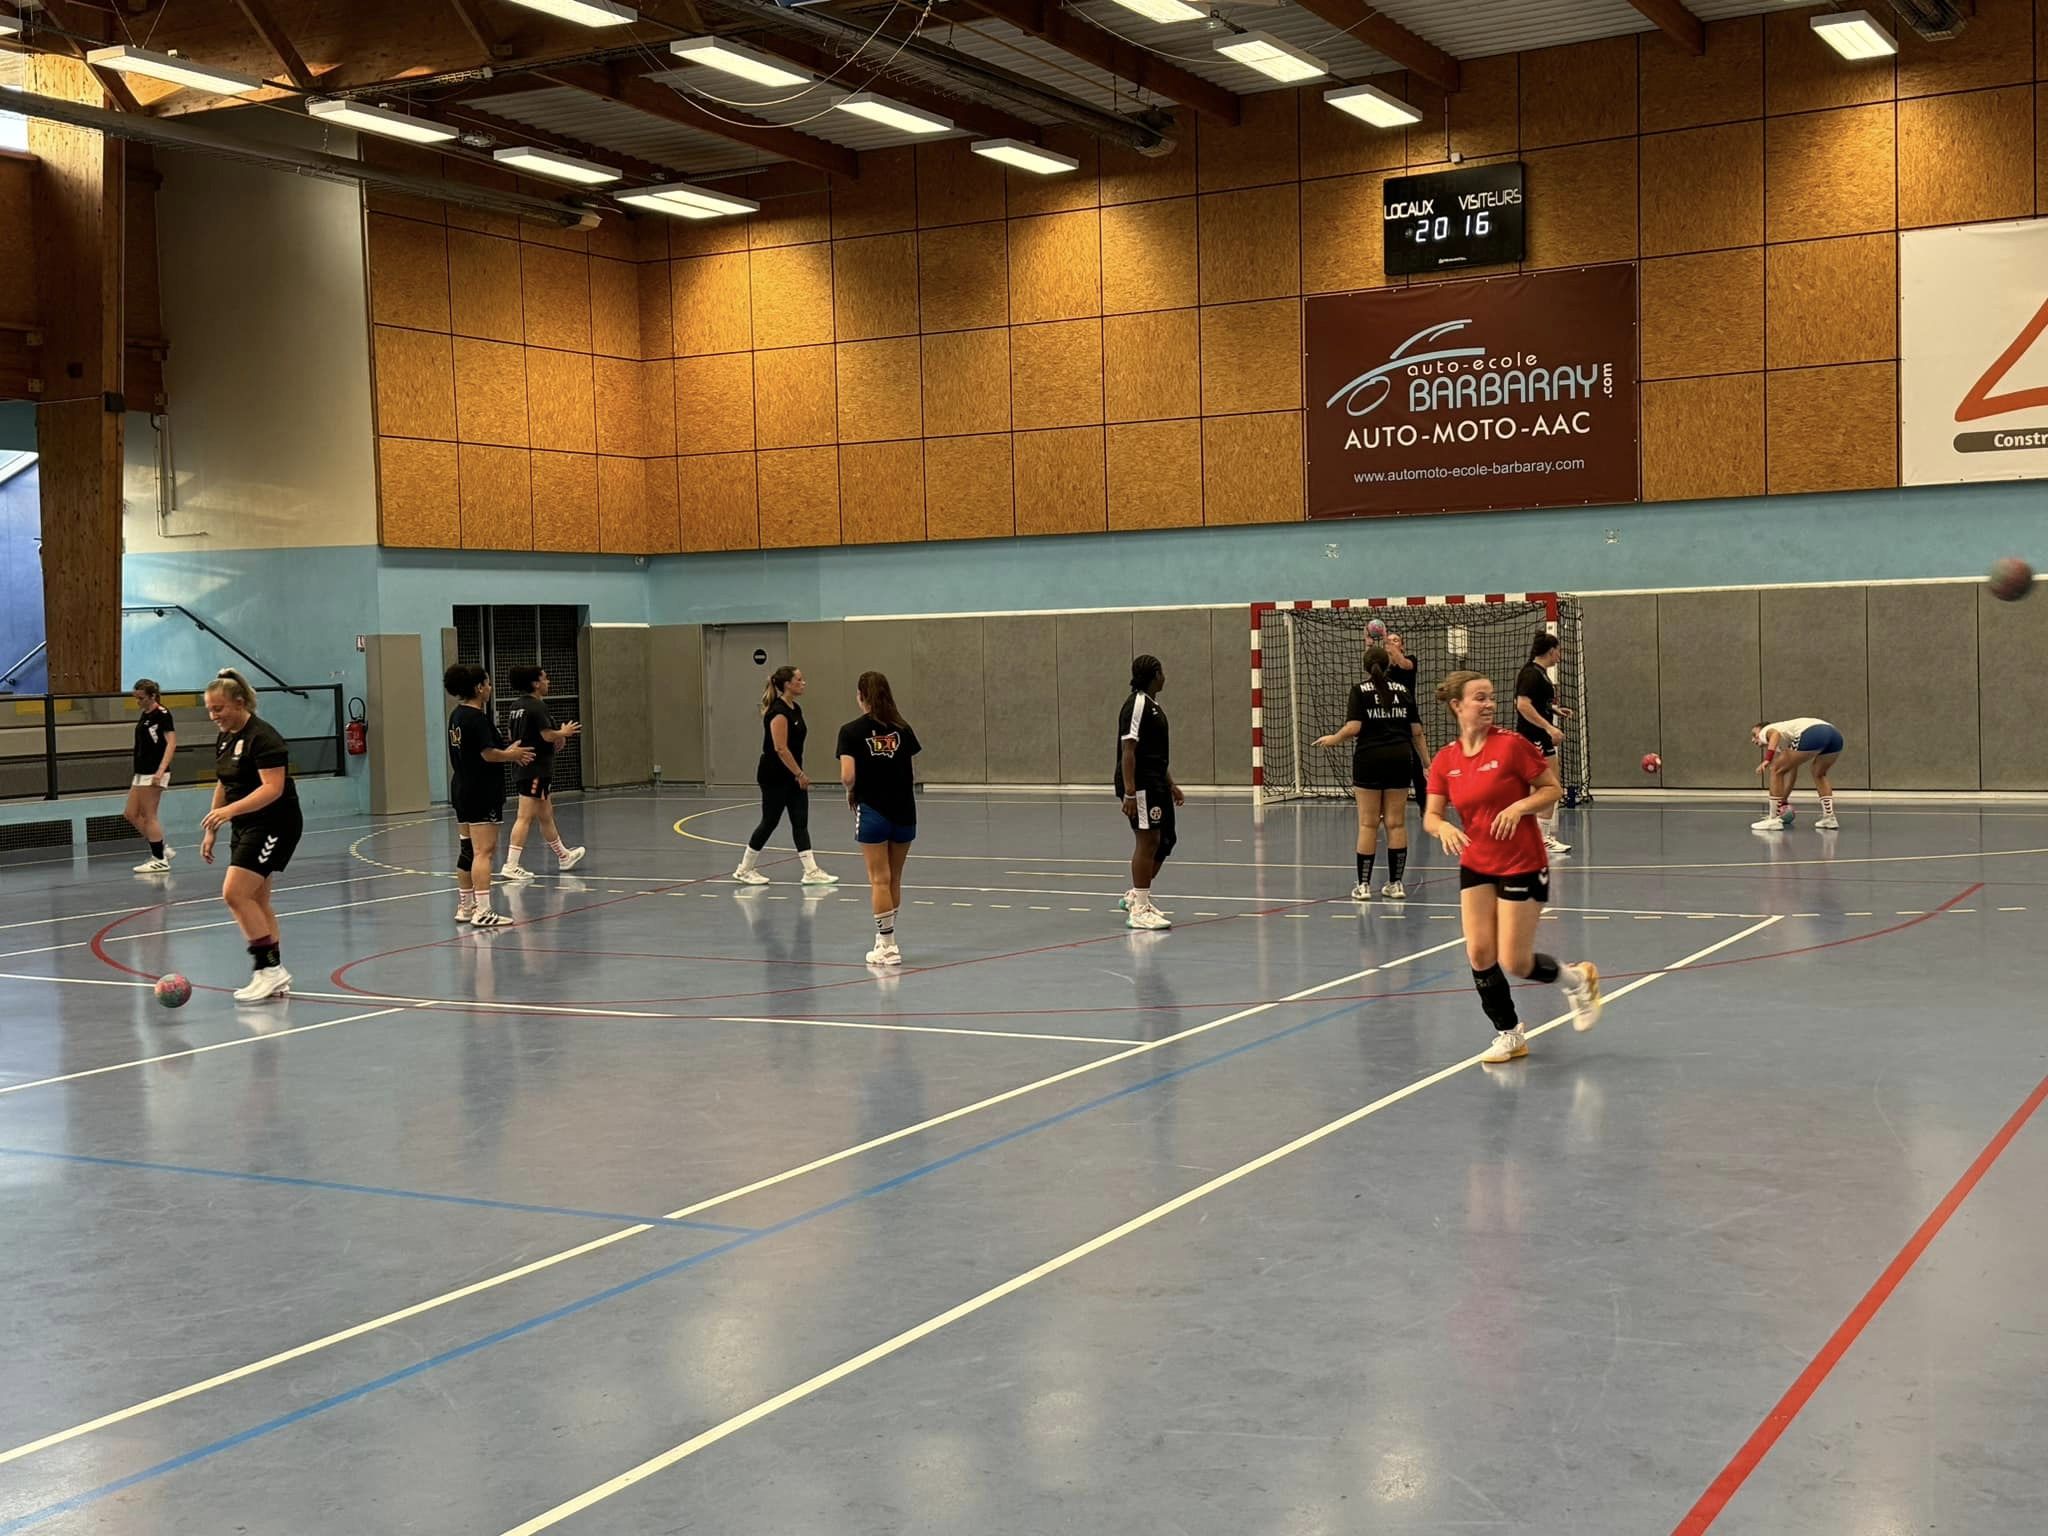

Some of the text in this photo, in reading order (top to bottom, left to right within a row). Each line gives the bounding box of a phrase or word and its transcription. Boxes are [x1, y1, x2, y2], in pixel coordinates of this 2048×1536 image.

[1384, 188, 1522, 220] LOCAUX VISITEURS
[1415, 211, 1489, 243] 20 16
[1407, 351, 1538, 377] auto-ecole
[1409, 363, 1598, 412] BARBARAY
[1603, 362, 1613, 399] .com
[1353, 457, 1585, 484] www.automoto-ecole-barbaray.com
